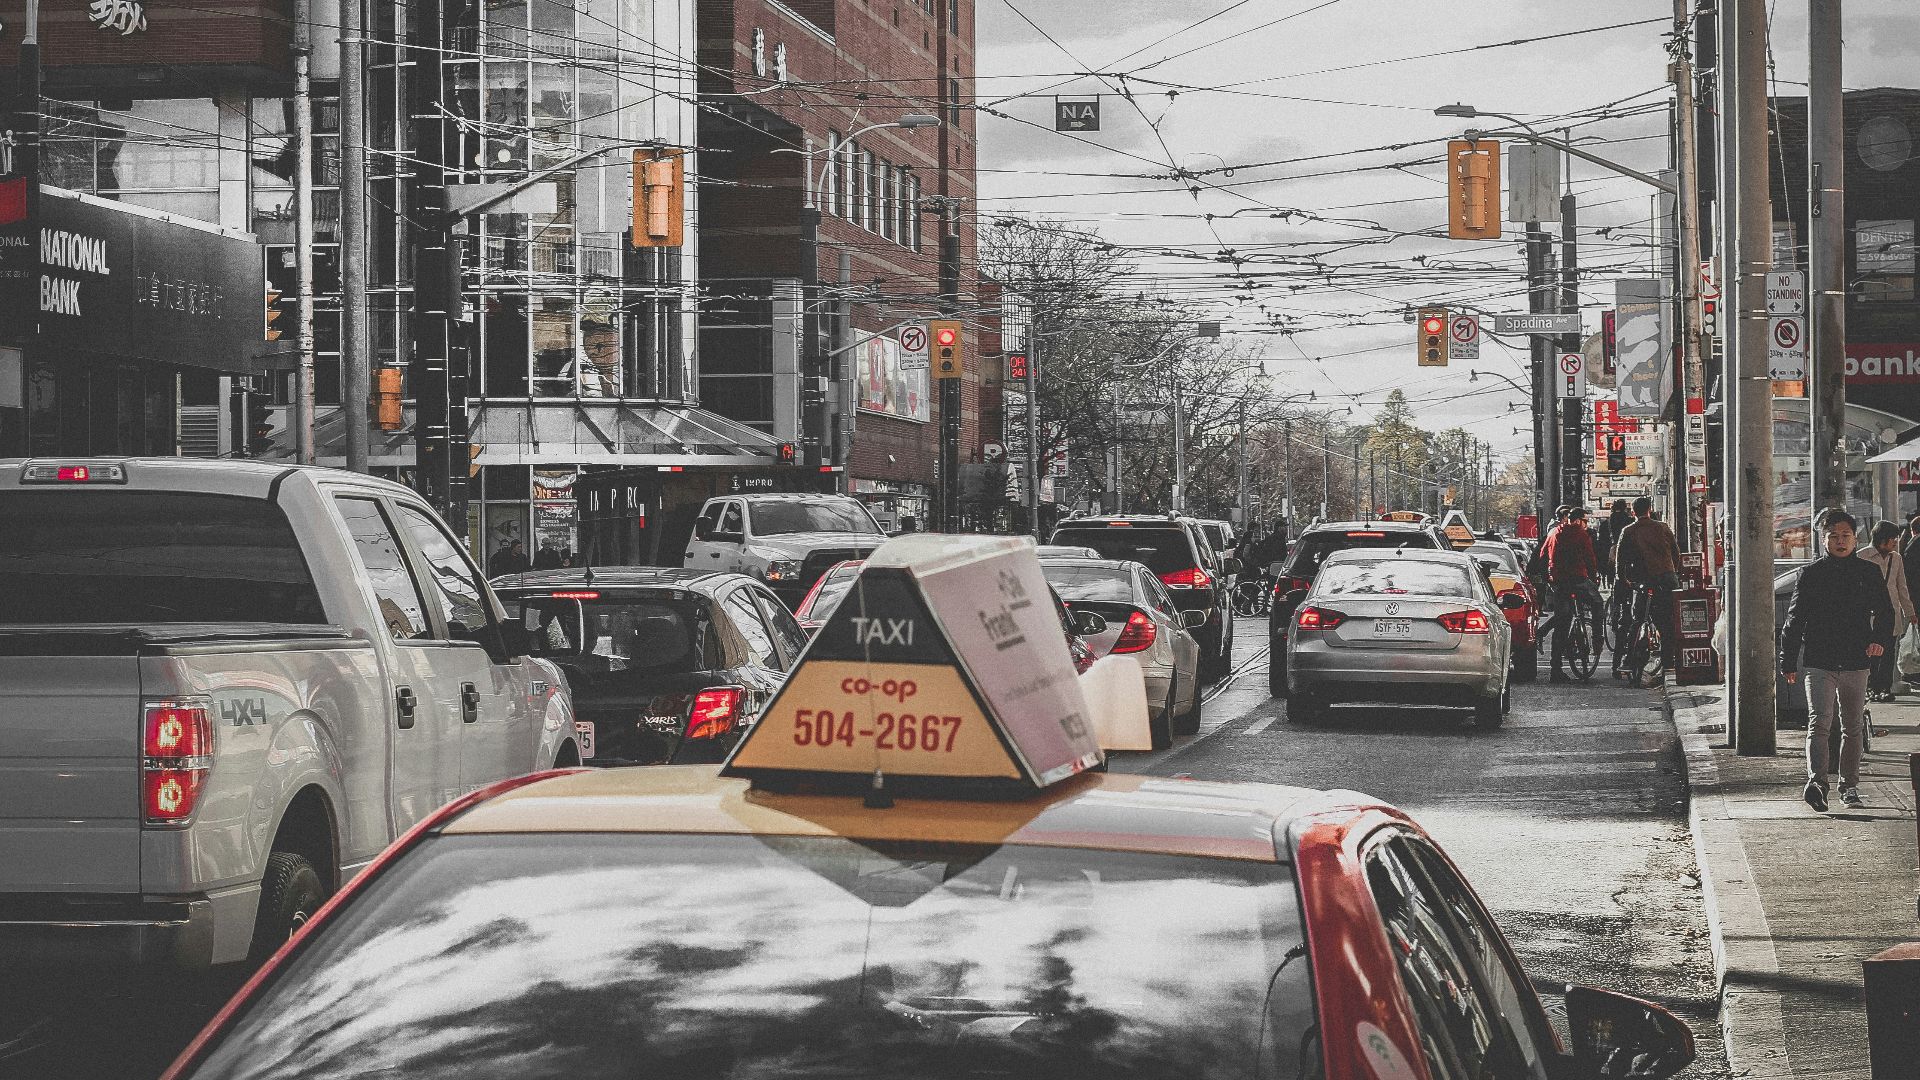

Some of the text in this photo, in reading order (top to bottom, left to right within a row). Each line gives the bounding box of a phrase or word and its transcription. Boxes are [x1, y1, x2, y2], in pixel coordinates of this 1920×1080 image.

[1860, 231, 1912, 243] DENTIST
[40, 227, 110, 275] NATIONAL
[1778, 276, 1790, 286] NO
[40, 274, 81, 317] BANK
[1767, 289, 1802, 300] STANDING
[1505, 317, 1553, 331] Spadina
[851, 617, 914, 646] TAXI
[1687, 649, 1708, 664] SUN
[841, 677, 917, 702] co-op
[643, 715, 677, 725] YARIS
[794, 710, 962, 752] 504-2667
